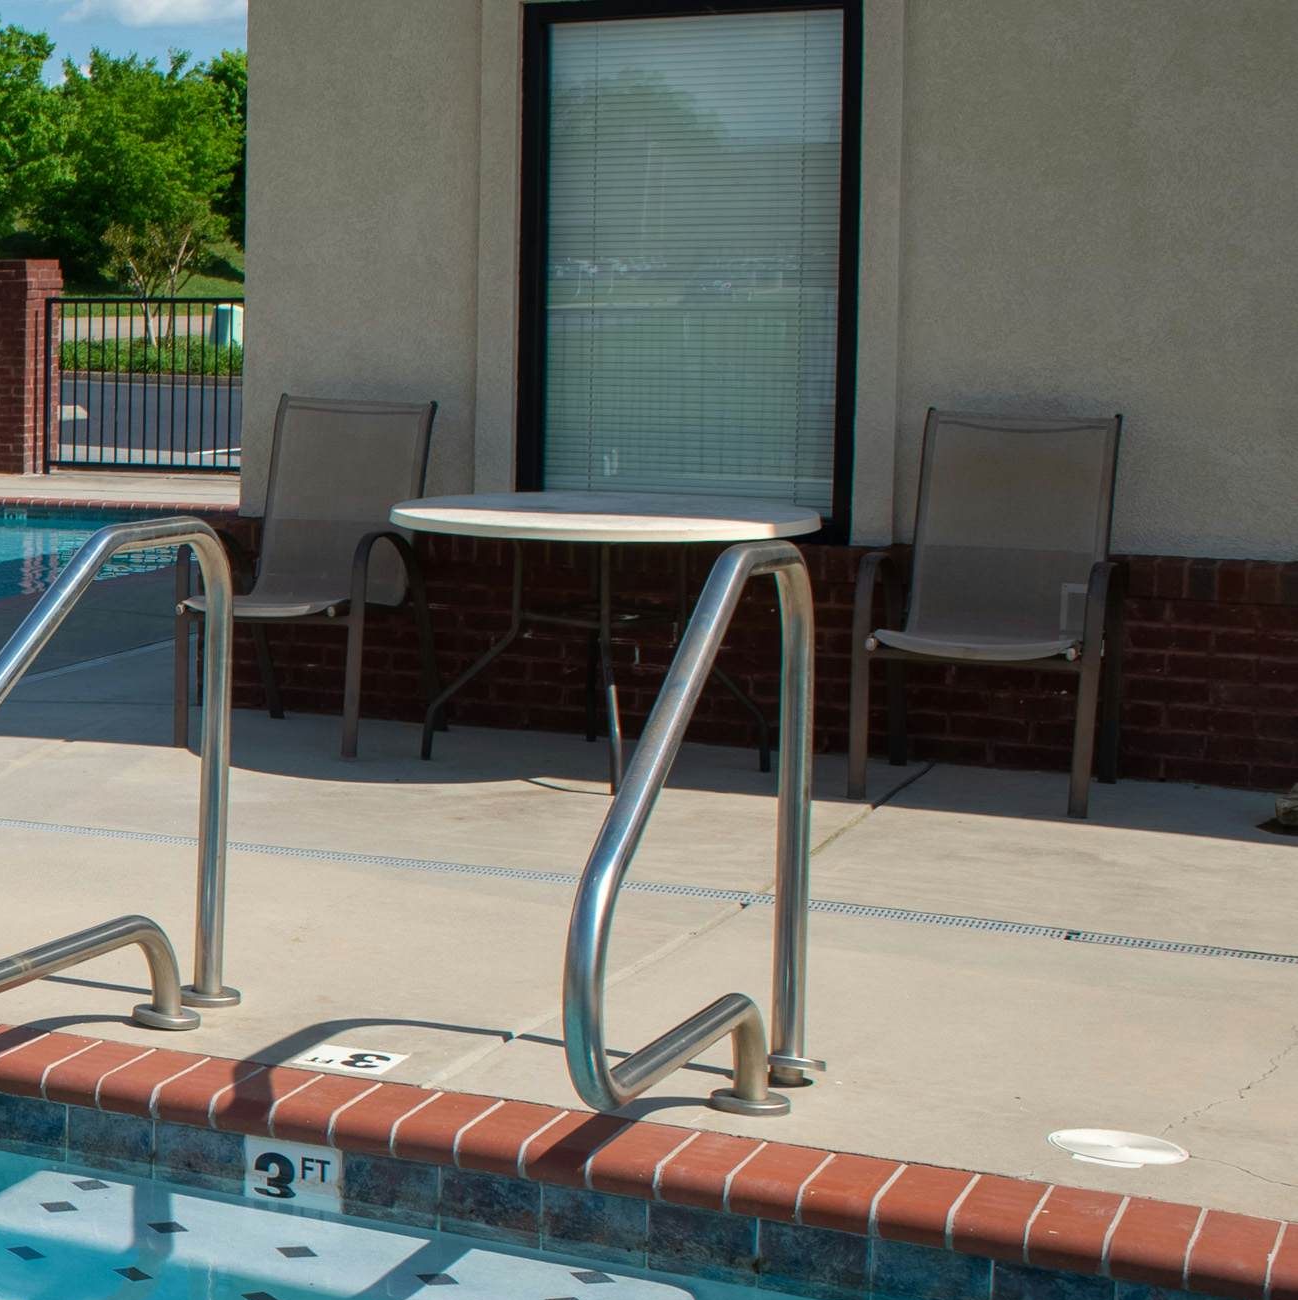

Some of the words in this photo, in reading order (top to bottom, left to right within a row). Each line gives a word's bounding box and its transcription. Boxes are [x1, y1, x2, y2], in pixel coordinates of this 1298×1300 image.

[340, 1053, 391, 1068] 3
[253, 1152, 296, 1199] 3
[301, 1156, 331, 1183] FT
